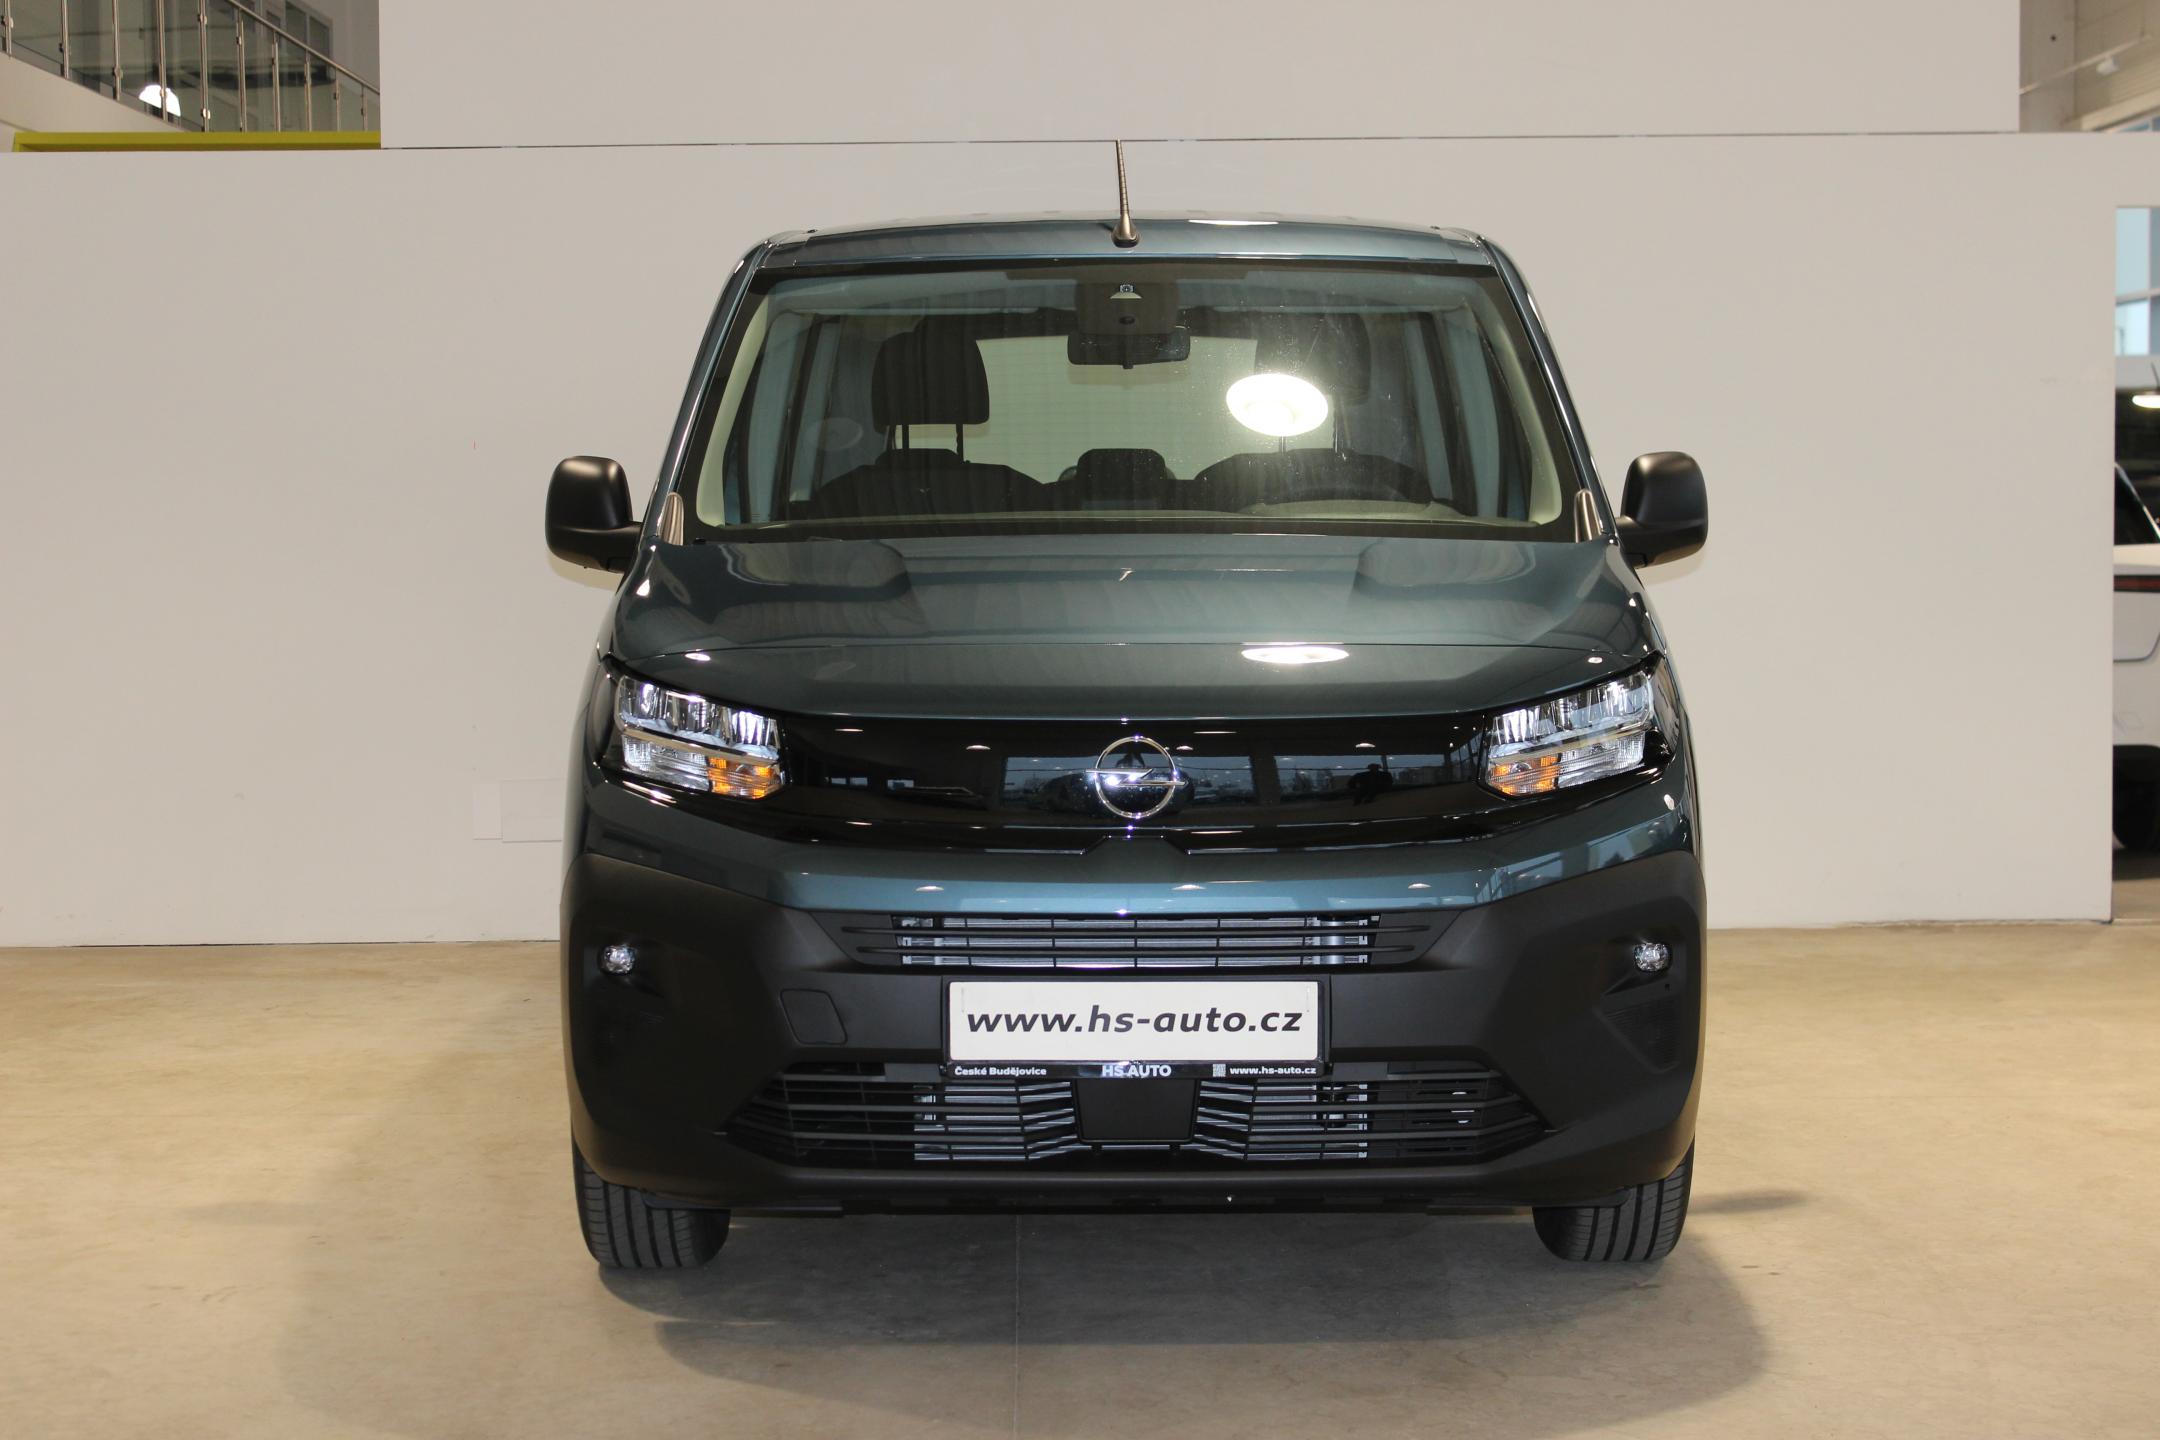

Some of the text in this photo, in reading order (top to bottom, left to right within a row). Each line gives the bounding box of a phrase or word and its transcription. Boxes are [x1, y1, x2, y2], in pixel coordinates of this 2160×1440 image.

[967, 1005, 1302, 1032] www.hs-auto.cz
[954, 1065, 1047, 1077] České Budějovice
[1127, 1064, 1172, 1077] AUTO
[1229, 1065, 1317, 1075] www.hs-auto.cz
